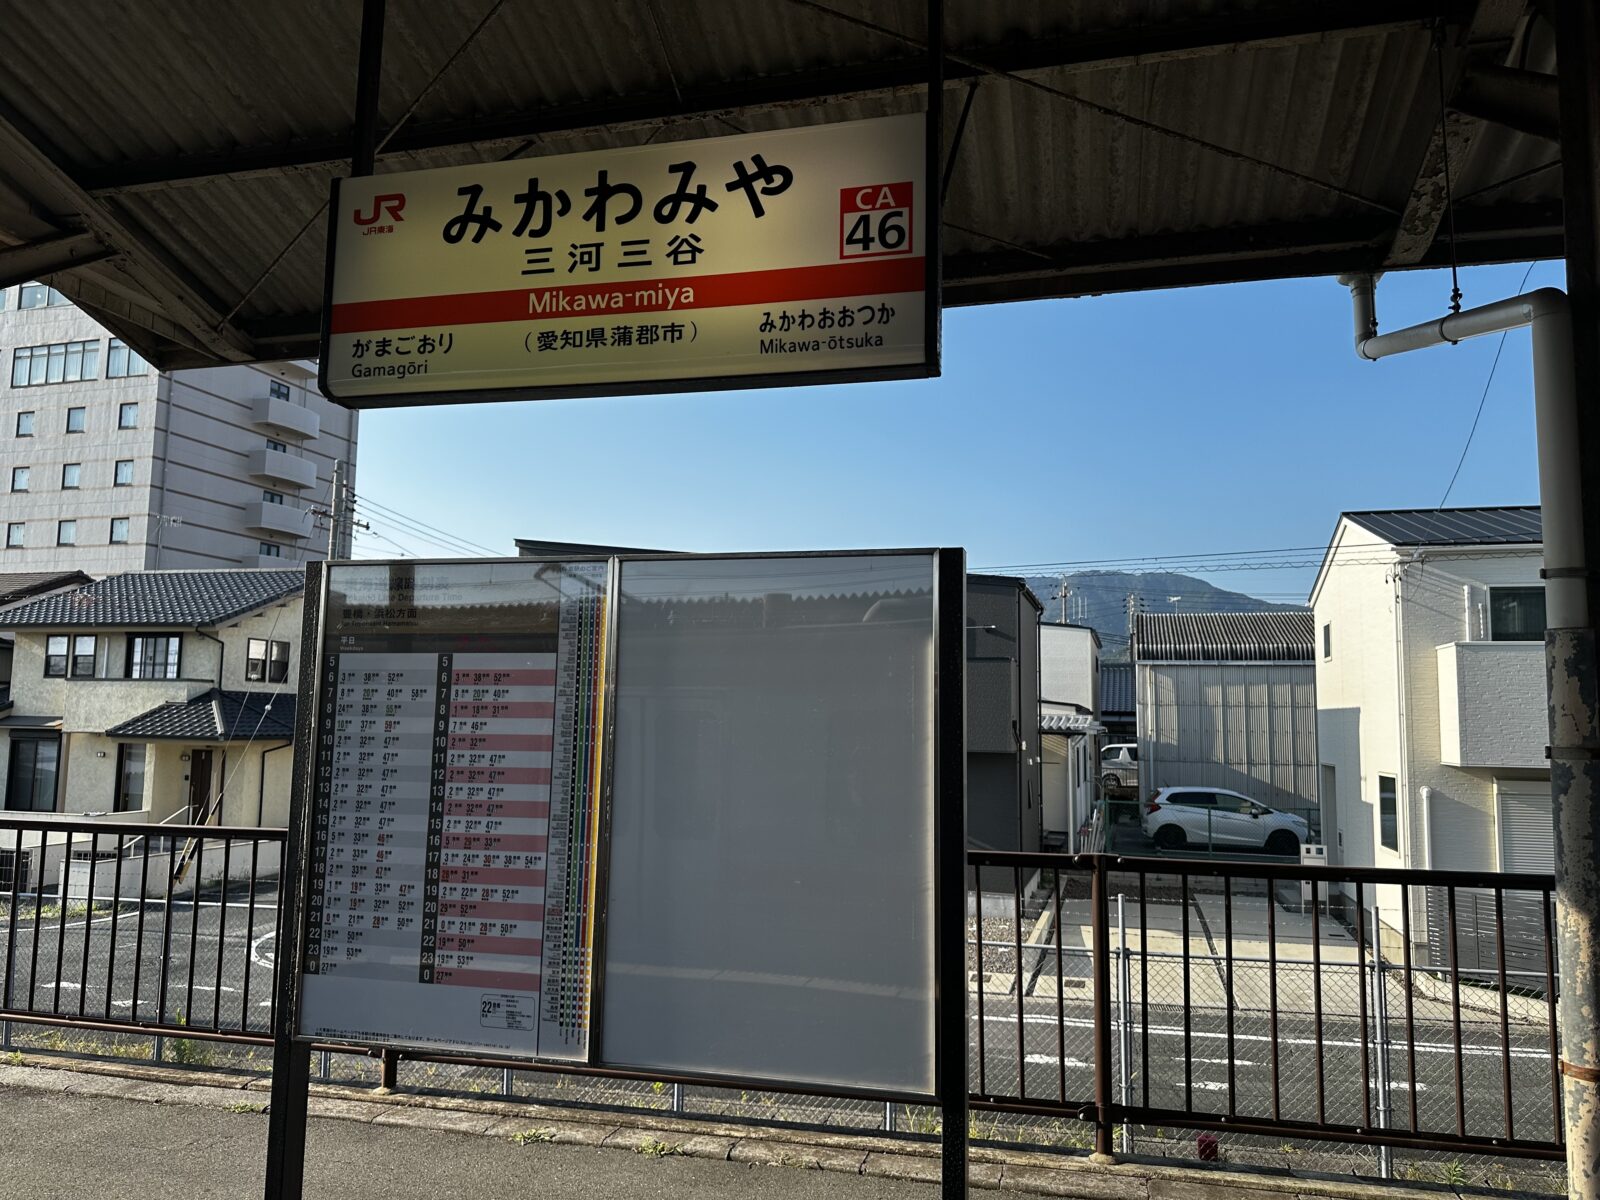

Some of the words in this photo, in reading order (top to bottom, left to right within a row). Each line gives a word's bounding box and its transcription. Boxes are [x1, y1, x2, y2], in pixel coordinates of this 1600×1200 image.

[442, 153, 794, 244] みかわみや
[855, 186, 896, 209] CA
[353, 193, 406, 225] JR
[362, 225, 394, 236] JR東海
[845, 211, 906, 251] 46
[521, 233, 705, 275] 三河三谷
[528, 283, 695, 315] Mikawa-miya
[759, 303, 896, 333] みかわおおつか
[351, 333, 454, 359] がまごおり
[759, 332, 884, 354] Mikawa-ōtsuka
[351, 360, 428, 379] Gamagōri
[330, 657, 335, 666] 5
[443, 657, 448, 666] 5
[328, 672, 334, 682] 6
[442, 673, 447, 682] 6
[328, 688, 333, 697] 7
[441, 689, 446, 698] 7
[327, 704, 332, 713] 8
[440, 705, 445, 714] 8
[326, 720, 331, 728] 9
[439, 721, 444, 730] 9
[322, 736, 333, 744] 10
[435, 738, 446, 747] 10
[322, 752, 331, 760] 11
[434, 754, 444, 763] 11
[320, 768, 330, 776] 12
[433, 770, 444, 779] 12
[320, 784, 329, 792] 13
[432, 787, 443, 796] 13
[318, 799, 328, 808] 14
[432, 802, 442, 812] 14
[317, 816, 327, 824] 15
[430, 819, 441, 828] 15
[316, 831, 326, 840] 16
[429, 836, 440, 845] 16
[315, 847, 325, 856] 17
[428, 853, 439, 862] 17
[314, 864, 324, 872] 18
[427, 869, 438, 878] 18
[313, 880, 323, 889] 19
[426, 886, 437, 895] 19
[312, 896, 322, 905] 20
[425, 902, 436, 912] 20
[310, 913, 320, 922] 21
[424, 919, 435, 929] 21
[309, 929, 320, 938] 22
[423, 936, 434, 946] 22
[308, 944, 319, 955] 23
[422, 953, 433, 963] 23
[310, 962, 315, 971] 0
[424, 970, 430, 980] 0
[482, 1001, 492, 1013] 22
